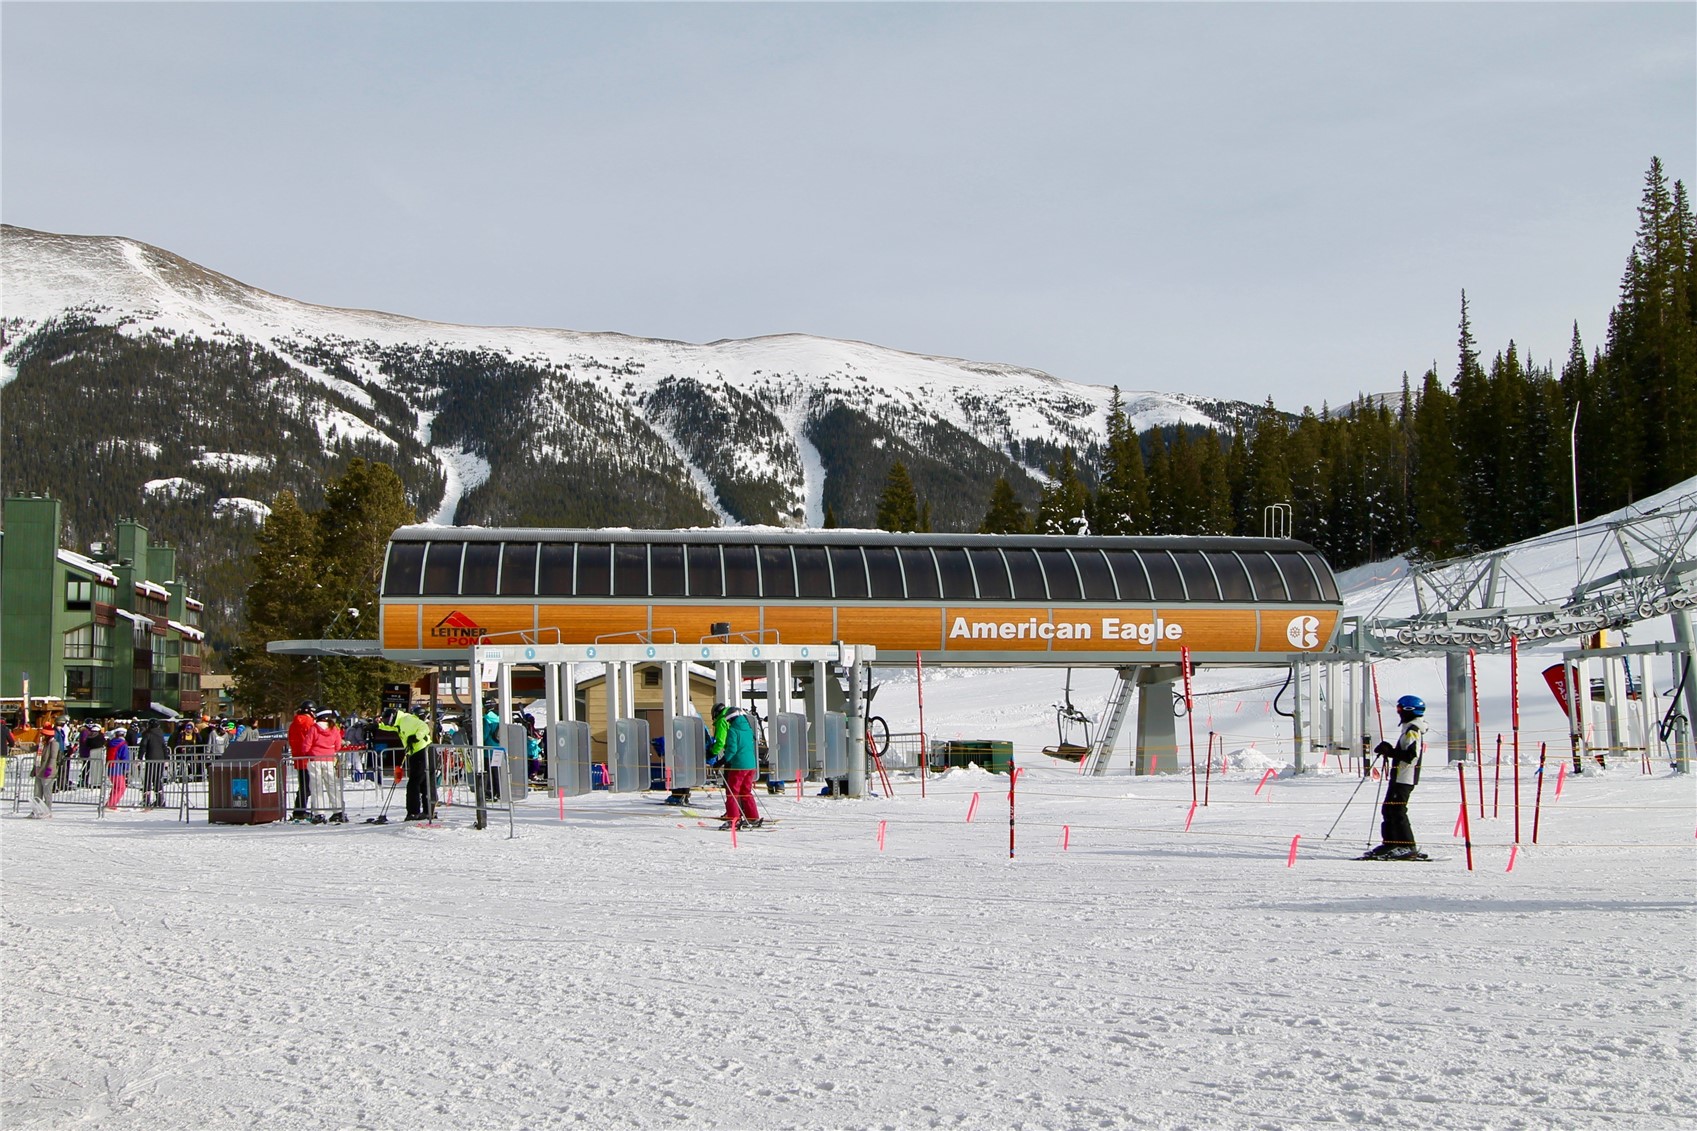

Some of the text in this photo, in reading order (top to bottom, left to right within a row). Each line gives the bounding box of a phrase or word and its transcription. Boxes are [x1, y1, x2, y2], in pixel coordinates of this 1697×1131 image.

[431, 627, 488, 637] LEITNER
[949, 616, 1183, 645] American Eagle
[447, 637, 494, 645] POMA
